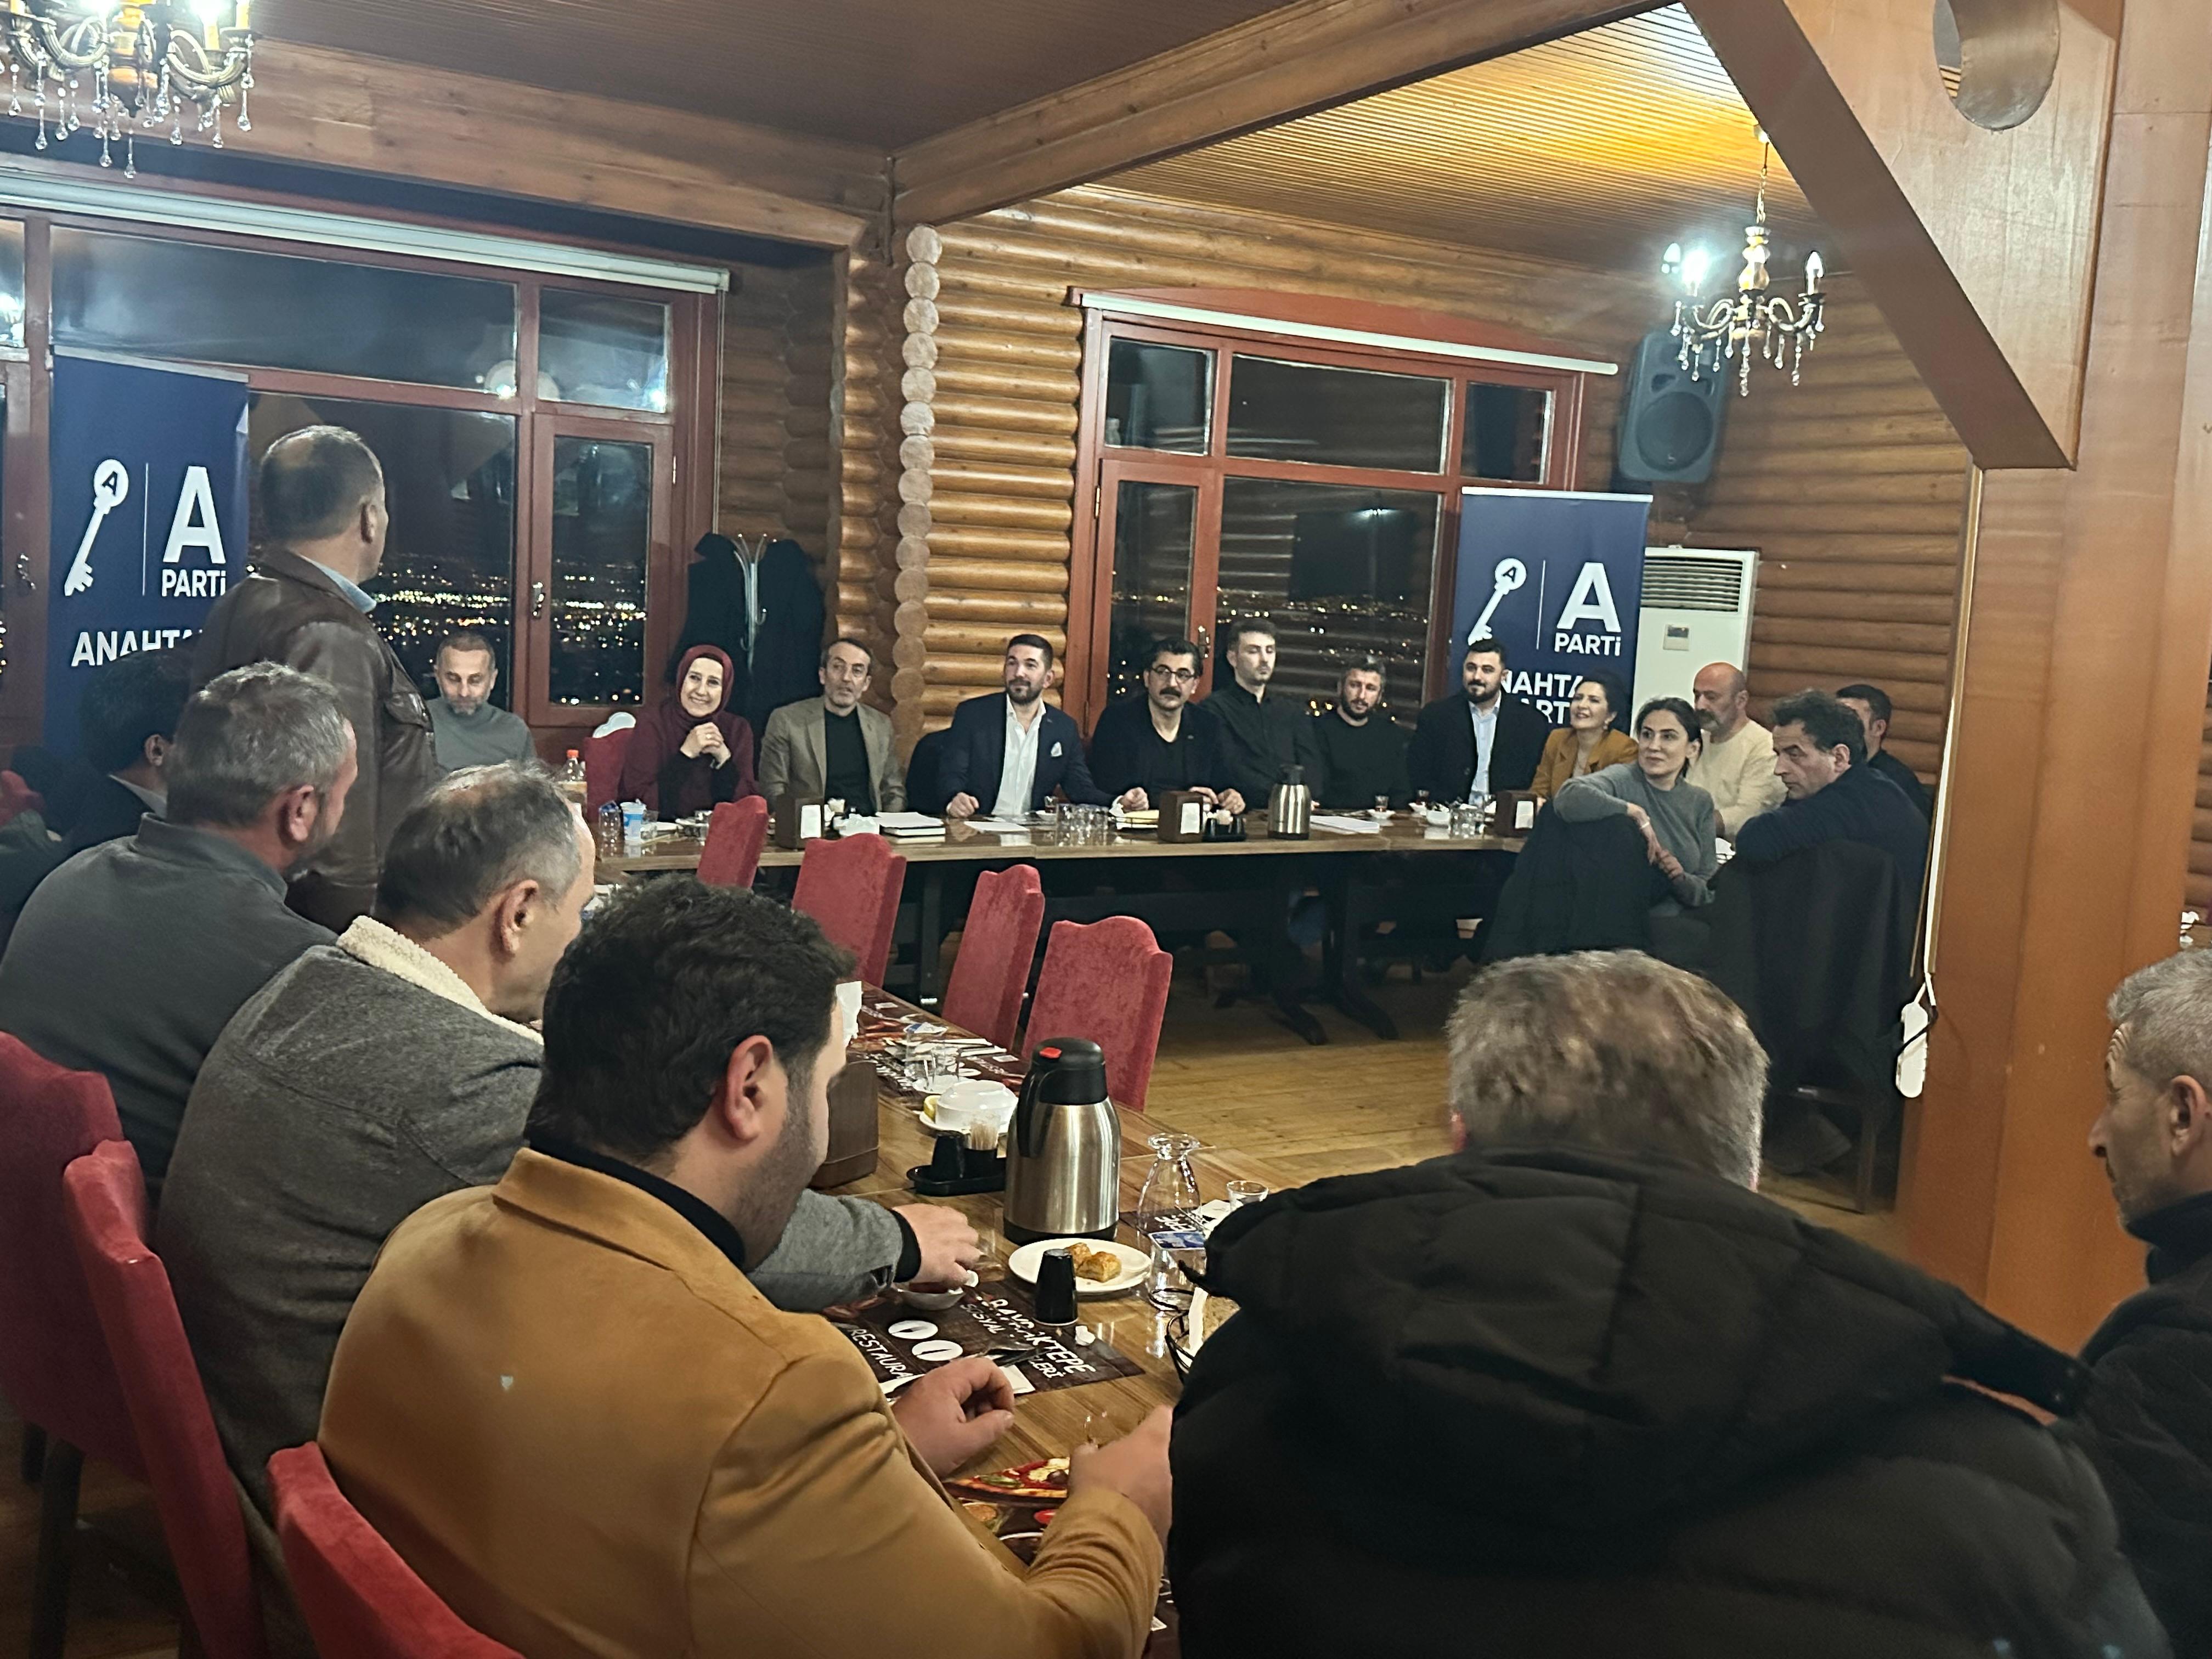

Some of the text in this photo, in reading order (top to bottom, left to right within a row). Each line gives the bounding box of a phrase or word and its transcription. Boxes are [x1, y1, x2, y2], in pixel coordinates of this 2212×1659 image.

[162, 466, 226, 564] A
[1556, 562, 1622, 633] A
[71, 629, 202, 667] ANAHT
[850, 1329, 914, 1379] RESTAURA
